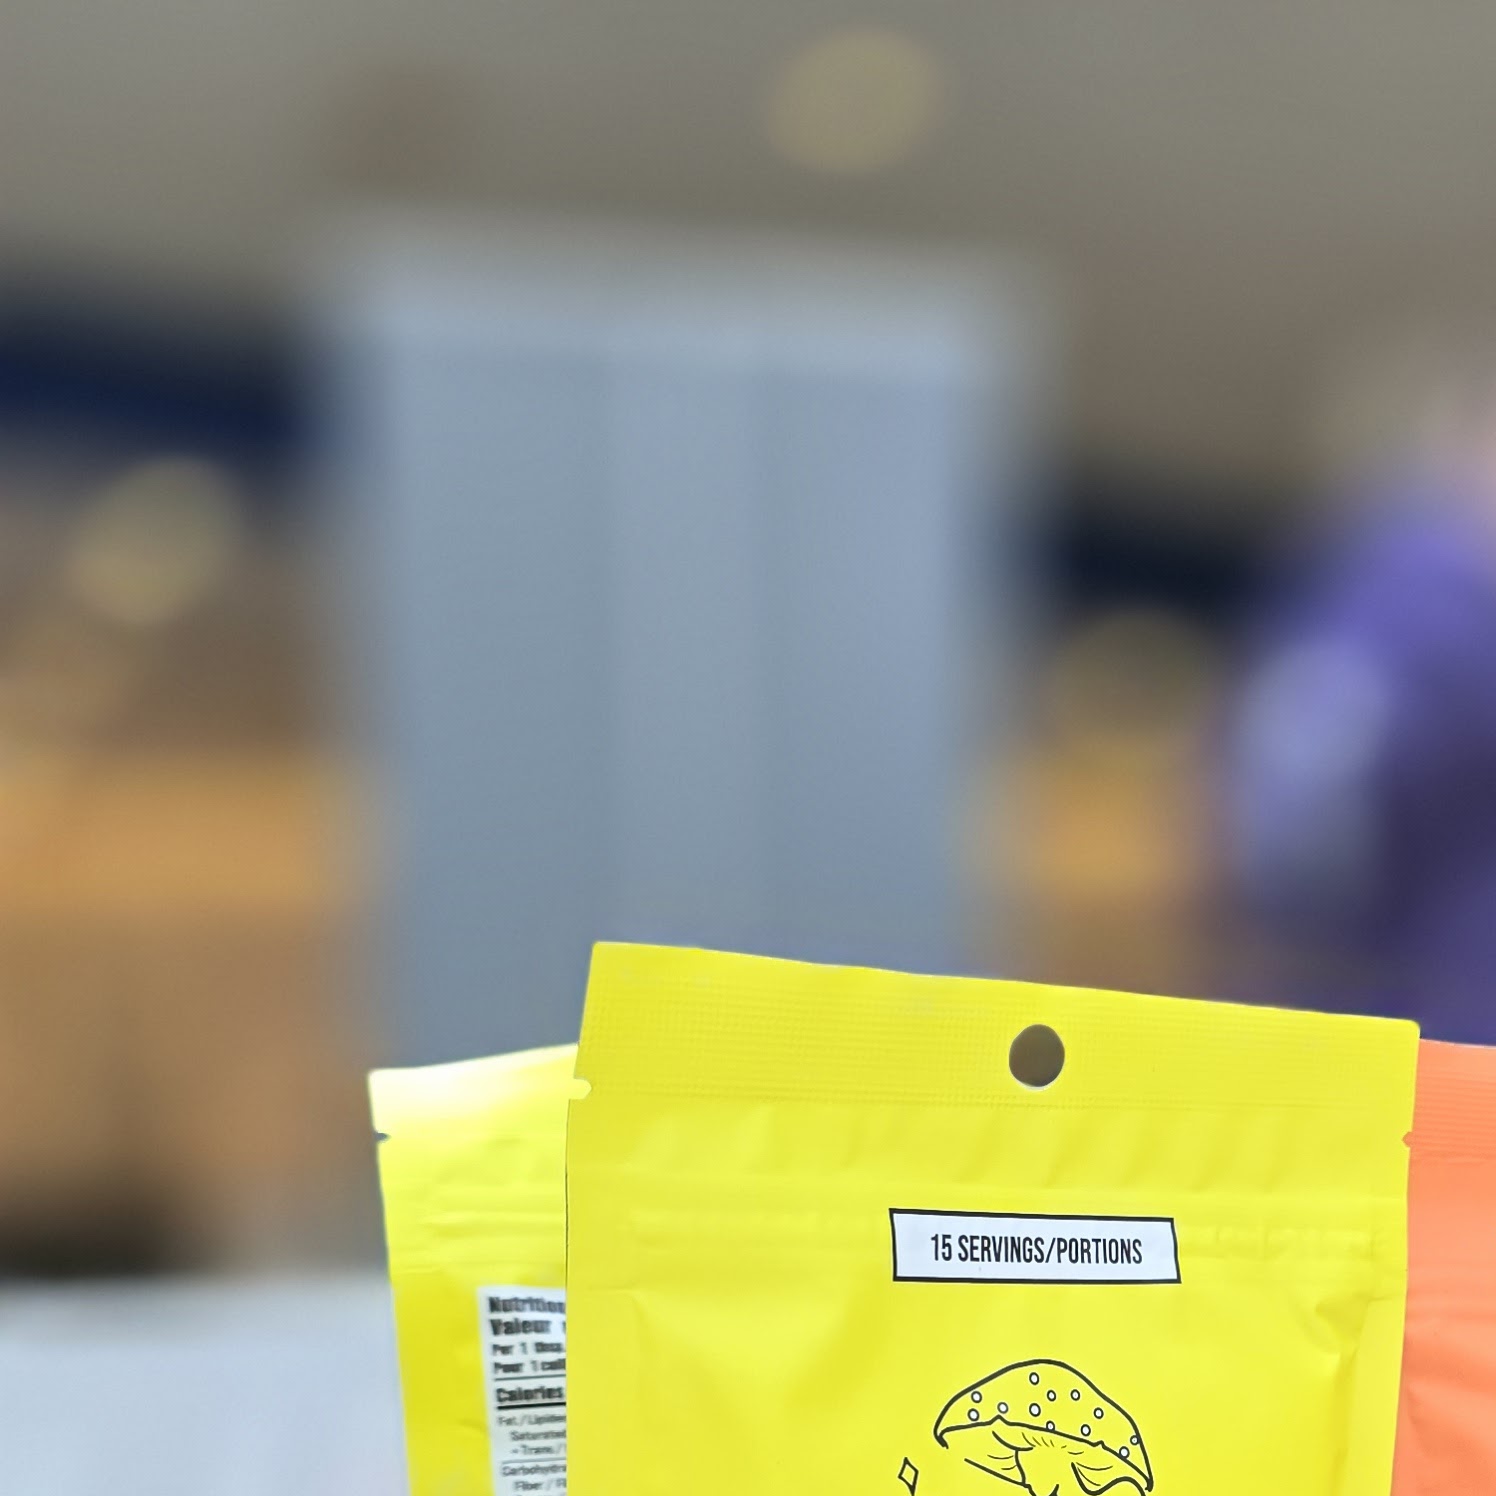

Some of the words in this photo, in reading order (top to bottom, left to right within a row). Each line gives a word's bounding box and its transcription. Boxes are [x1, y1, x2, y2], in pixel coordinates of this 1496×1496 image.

[930, 1234, 953, 1262] 15
[957, 1235, 1143, 1265] SERVINGS/PORTIONS
[496, 1386, 563, 1402] Calories
